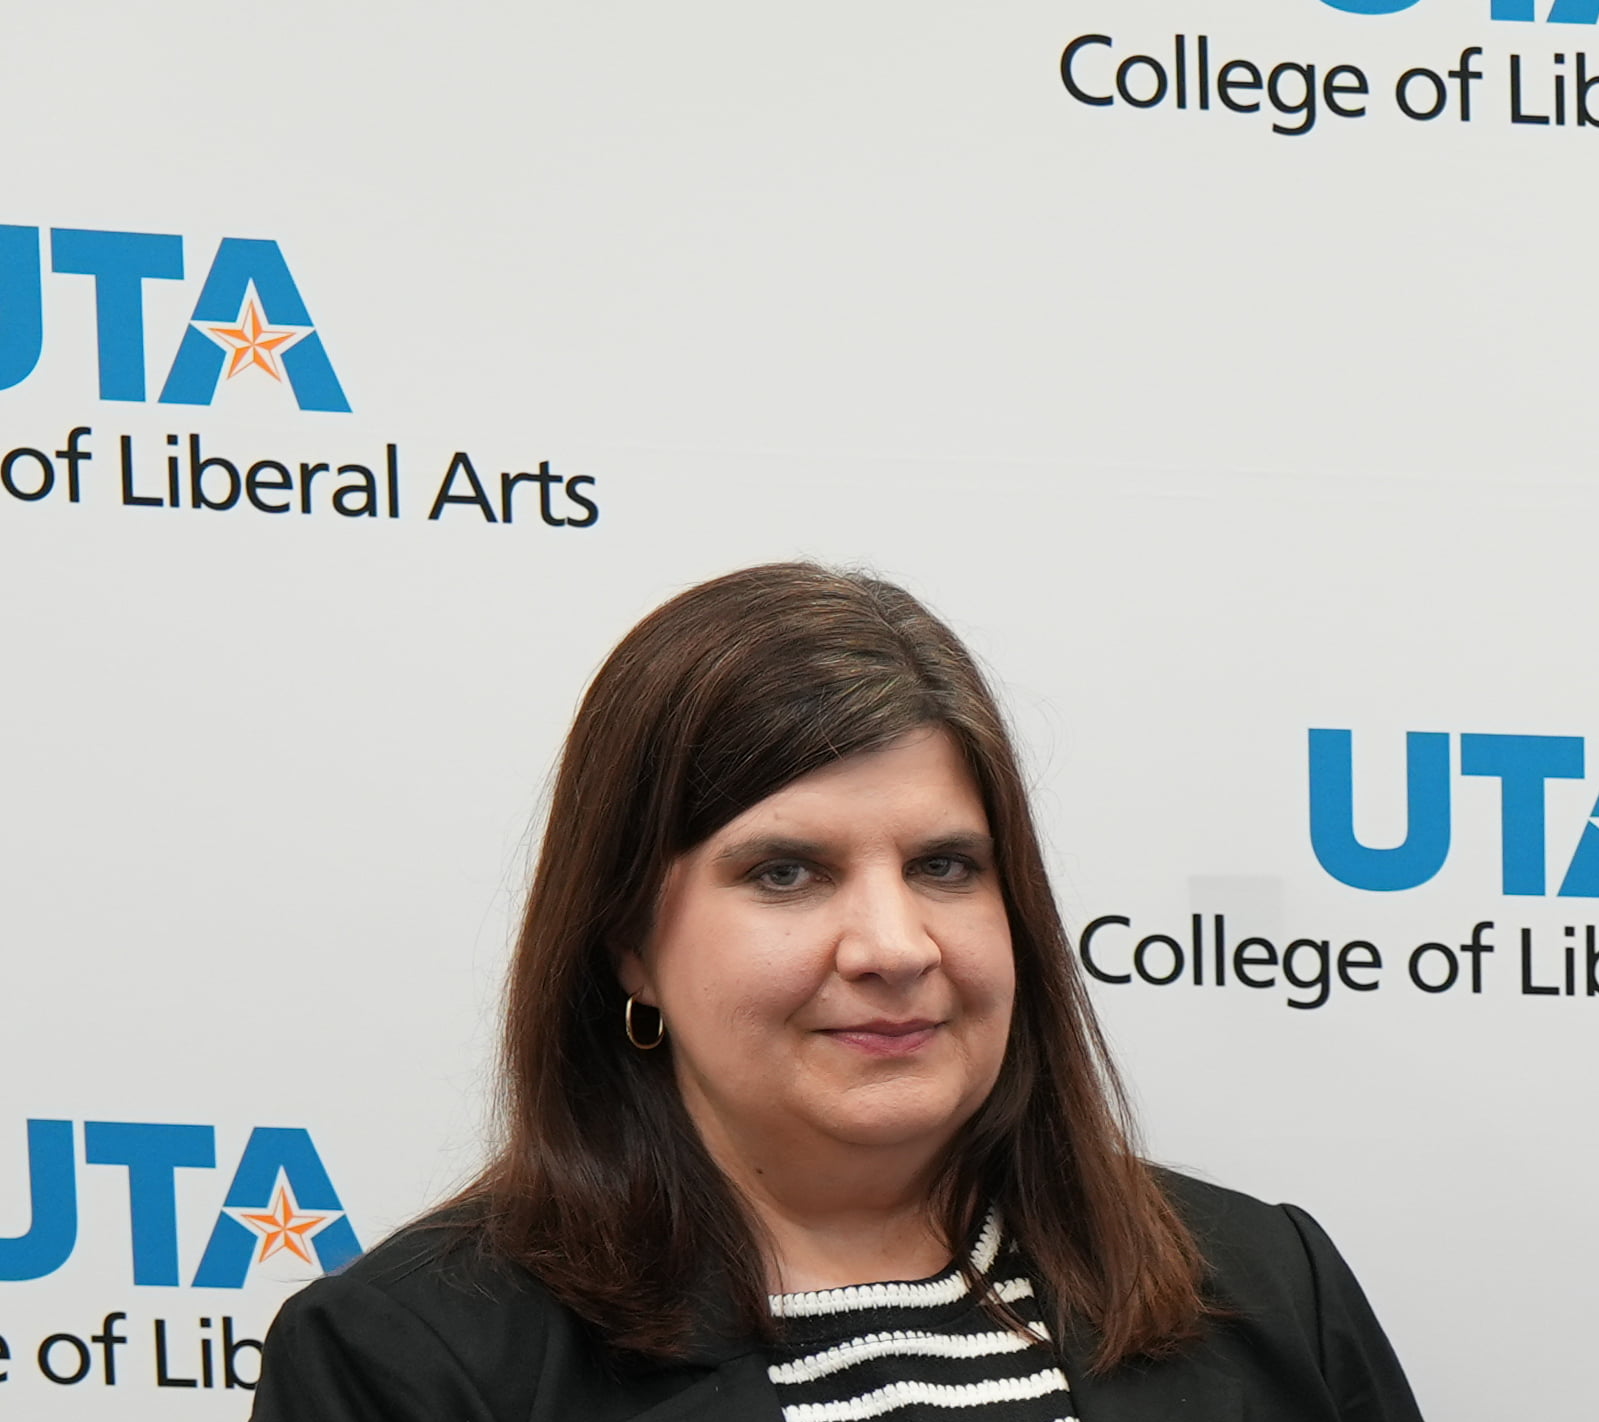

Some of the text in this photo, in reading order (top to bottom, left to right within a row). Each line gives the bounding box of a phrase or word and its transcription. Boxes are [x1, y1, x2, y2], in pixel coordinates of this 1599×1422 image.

[1059, 34, 1369, 136] College
[1395, 45, 1484, 122] of
[0, 426, 600, 528] of Liberal Arts
[1079, 913, 1383, 1010] College
[1408, 921, 1495, 995] of
[37, 1312, 127, 1386] of
